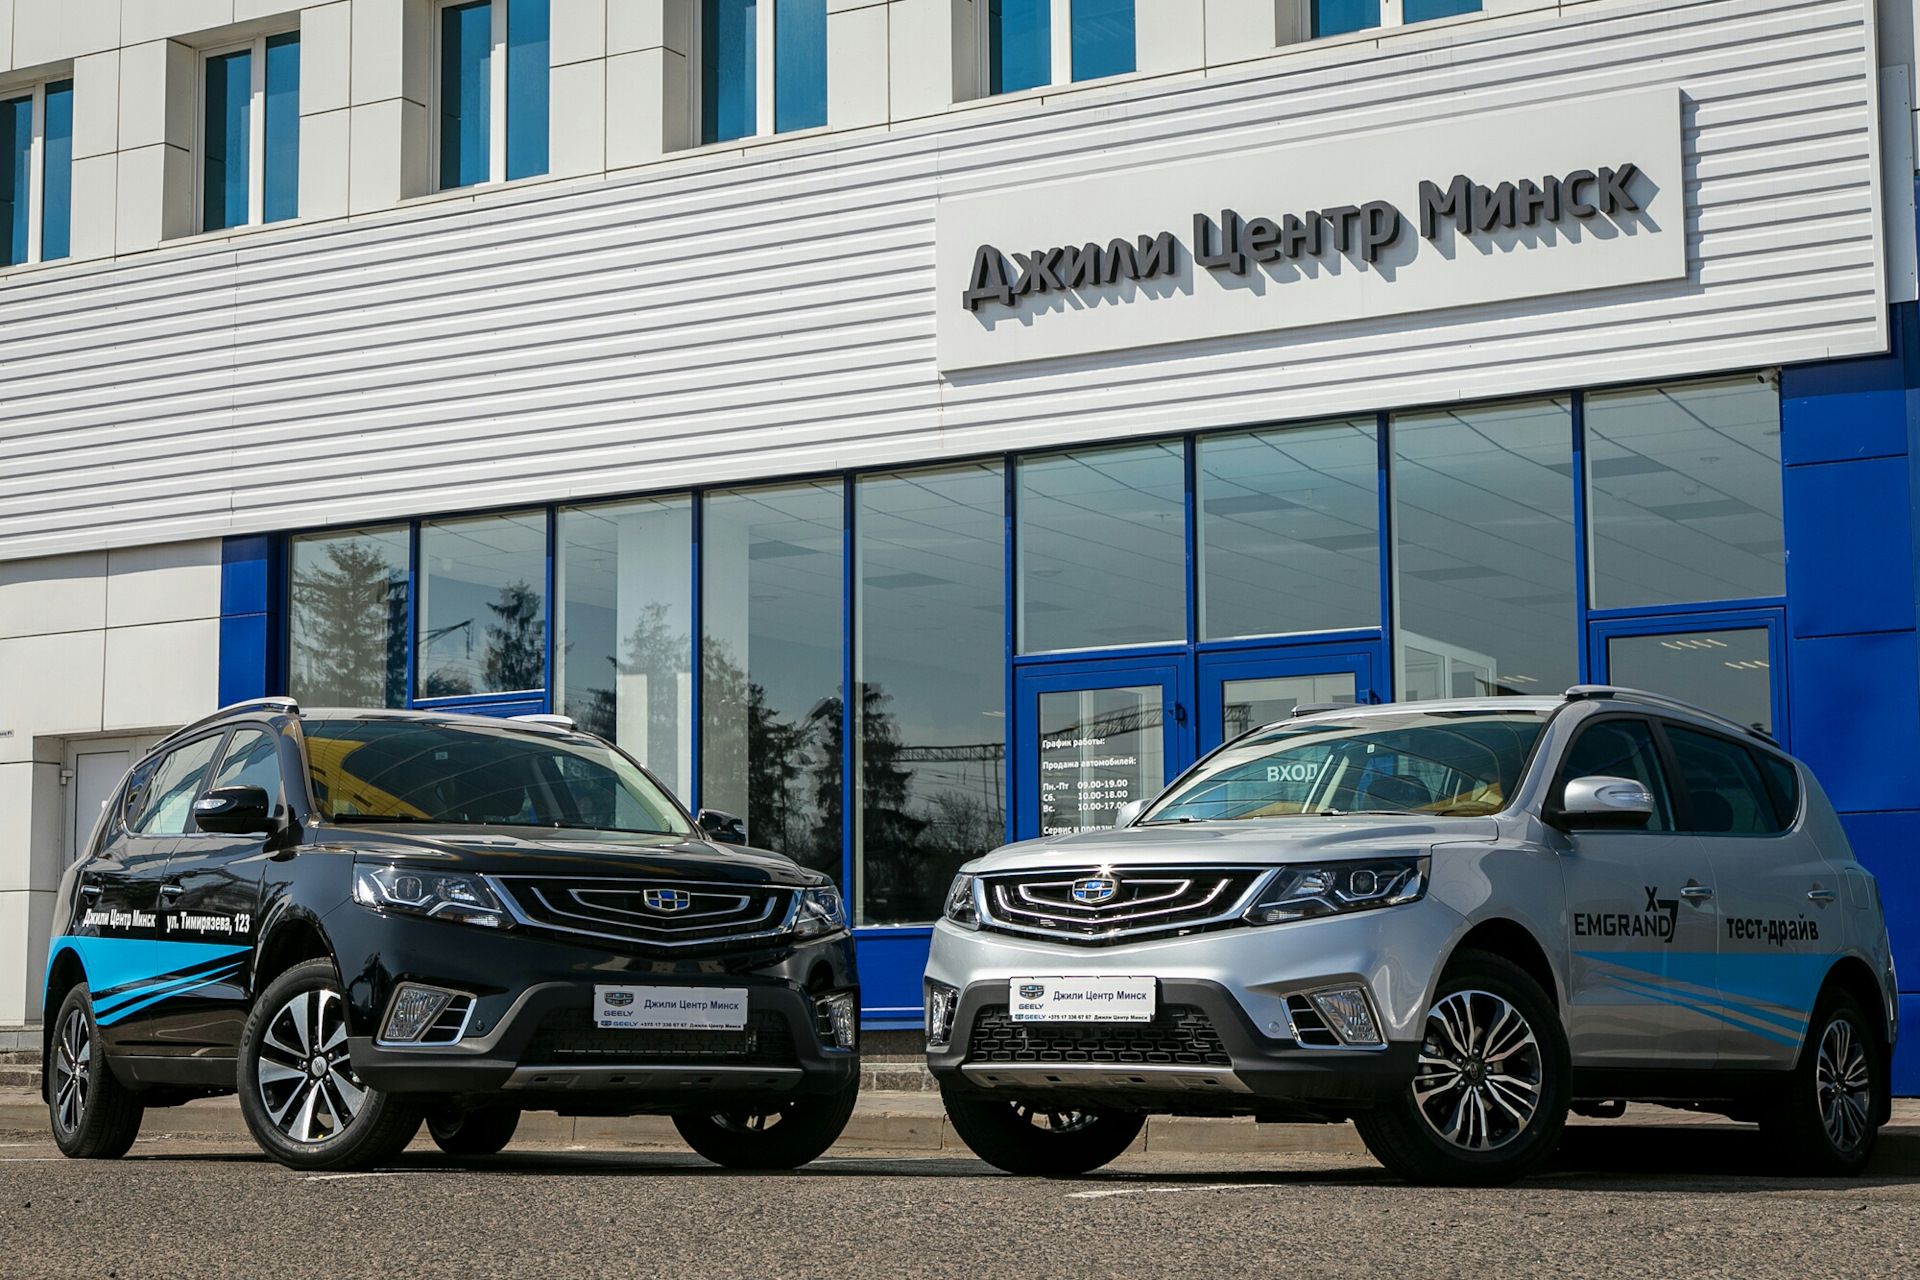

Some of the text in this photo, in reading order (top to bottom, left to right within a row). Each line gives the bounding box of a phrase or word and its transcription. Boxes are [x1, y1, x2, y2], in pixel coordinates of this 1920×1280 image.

[963, 162, 1641, 310] Джили Центр Минск
[1042, 738, 1105, 749] График работы:
[1042, 757, 1136, 770] Продажа автомобилей:
[1077, 779, 1128, 789] 09.00-19.00
[1078, 790, 1128, 800] 10.00-18.00
[83, 908, 250, 936] Джили Центр Минск ул. Тимирязева, 123
[1574, 913, 1671, 937] EMGRAND
[1726, 913, 1819, 947] тест-драйв
[1053, 991, 1147, 1002] Джили Центр Минск
[644, 999, 739, 1011] Джили Центр Минск
